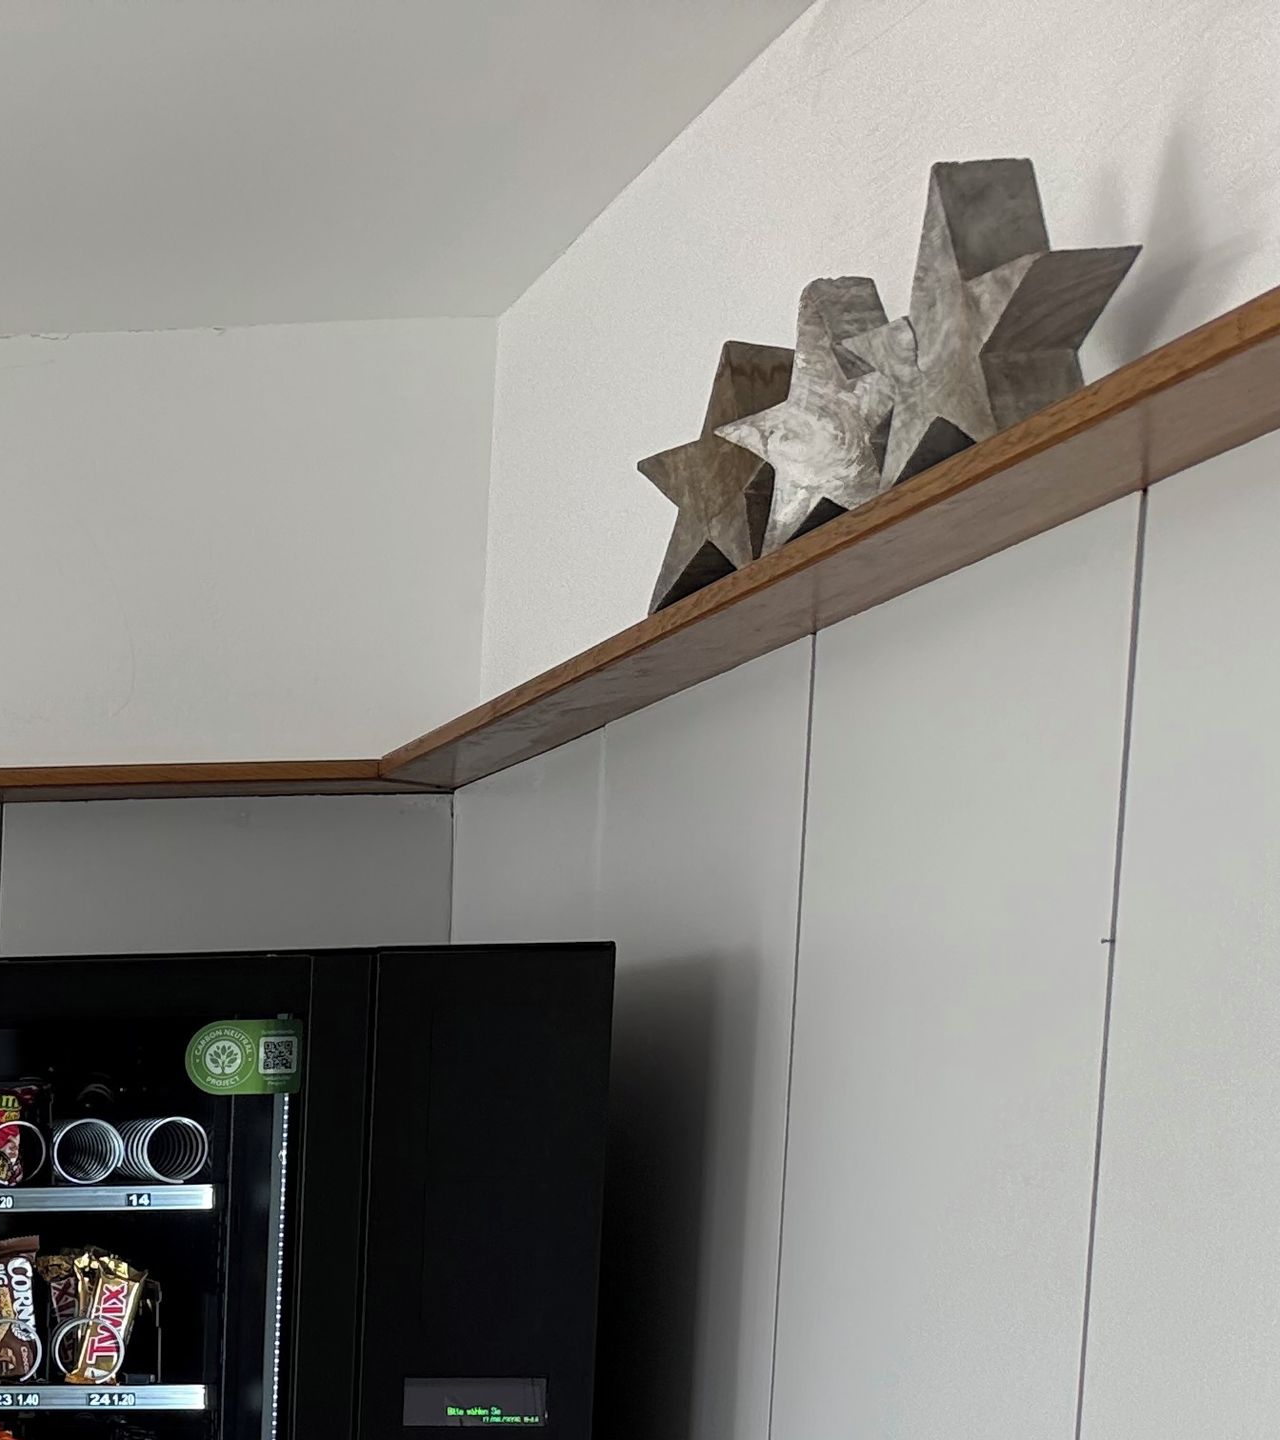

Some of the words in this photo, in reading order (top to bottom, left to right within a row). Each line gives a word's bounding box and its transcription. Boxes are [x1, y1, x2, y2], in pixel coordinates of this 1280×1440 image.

[195, 1029, 222, 1055] CARBON
[224, 1029, 253, 1054] NEUTRAL
[206, 1076, 240, 1086] PROJECT
[129, 1195, 150, 1206] 14
[17, 1394, 39, 1405] 1.40
[90, 1394, 110, 1405] 24
[113, 1394, 134, 1405] 1.20
